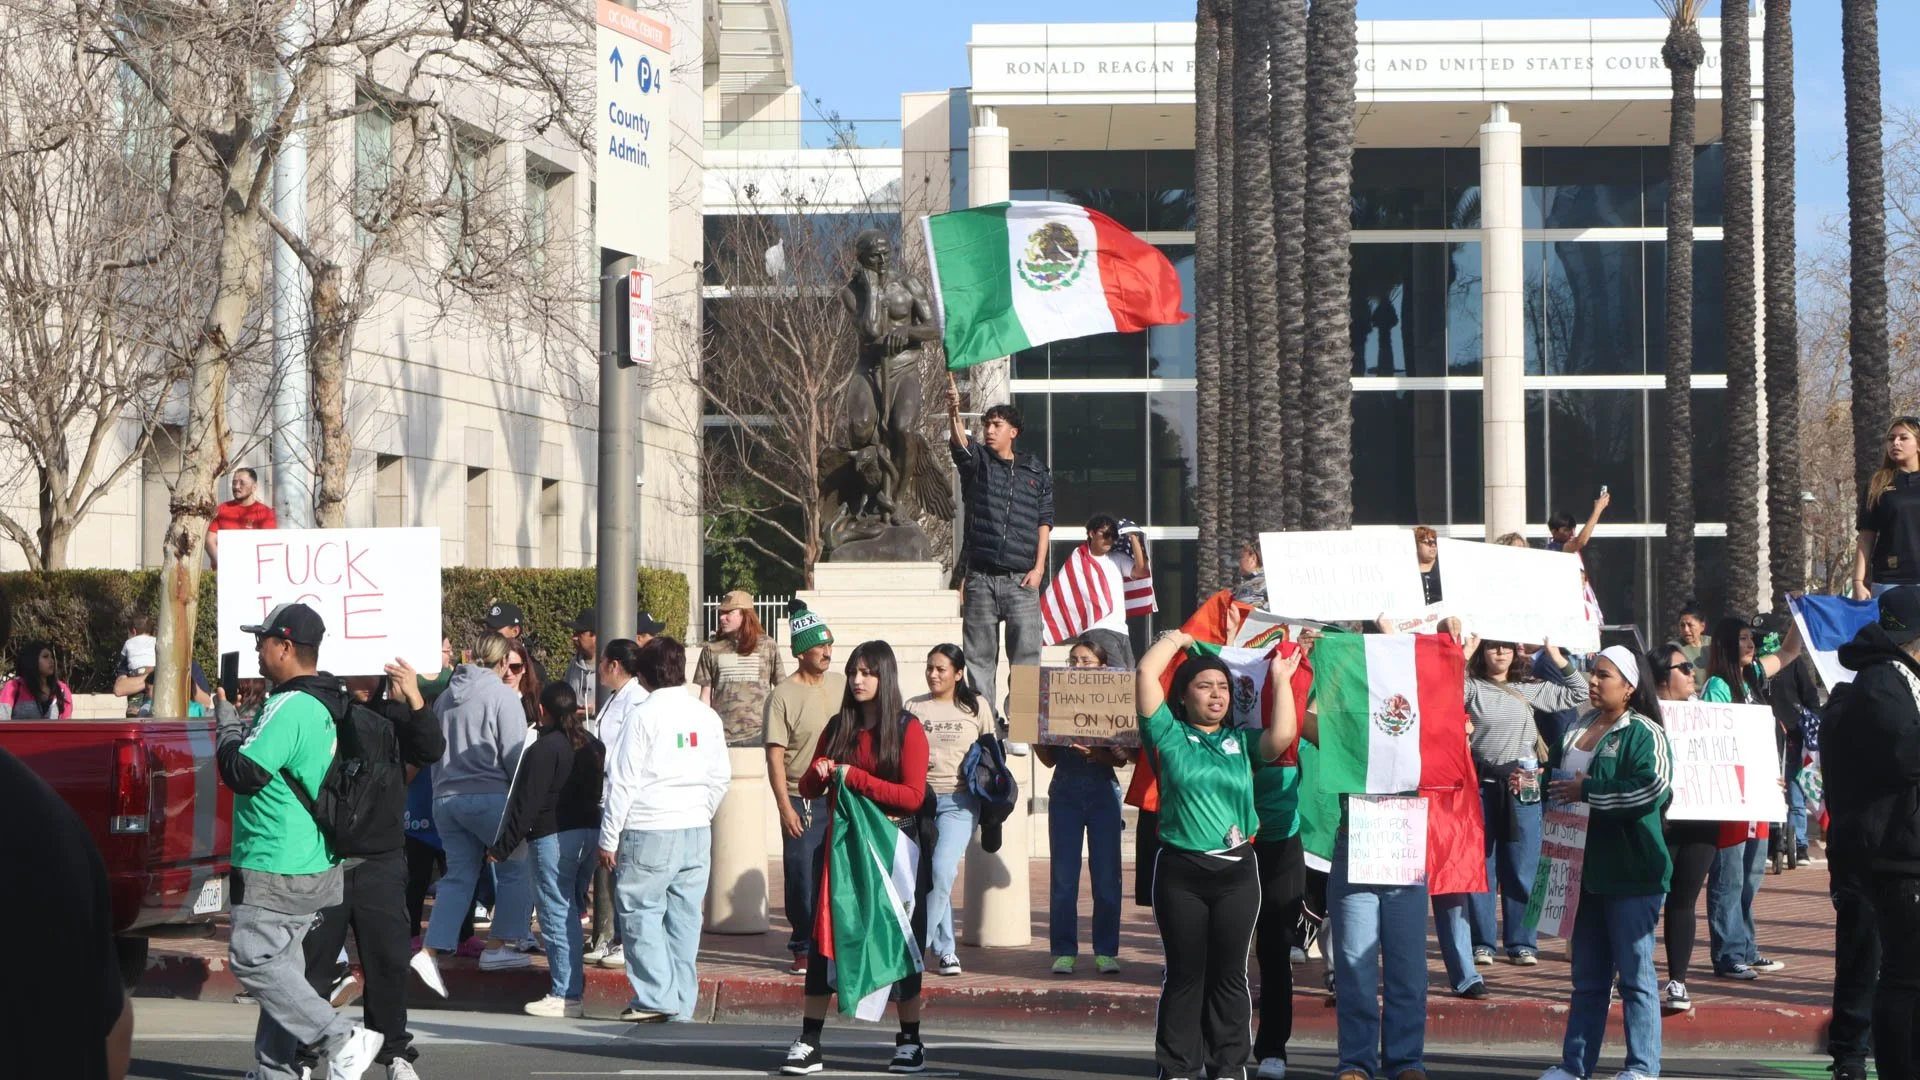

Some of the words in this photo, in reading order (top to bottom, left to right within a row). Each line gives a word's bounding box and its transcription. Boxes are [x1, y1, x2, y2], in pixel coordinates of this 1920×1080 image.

[621, 14, 637, 32] CIVIC
[640, 22, 663, 42] CENTER
[1006, 61, 1085, 74] RONALD
[1098, 60, 1174, 73] REAGAN
[1387, 58, 1428, 71] AND
[1440, 57, 1515, 71] UNITED
[1526, 57, 1594, 70] STATES
[653, 68, 661, 94] 4
[608, 102, 650, 141] County
[608, 135, 650, 168] Admin.
[631, 274, 641, 295] NO
[256, 540, 379, 589] FUCK
[1051, 672, 1064, 684] IT
[1067, 672, 1078, 684] IS
[1079, 673, 1115, 685] BETTER
[1118, 673, 1131, 684] TO
[1052, 692, 1085, 704] THAN
[1089, 693, 1104, 704] TO
[1107, 693, 1132, 704] LIVE
[1073, 712, 1098, 727] ON
[1105, 714, 1139, 729] YOU
[1389, 817, 1412, 830] FOR
[1350, 831, 1361, 845] MY
[1391, 848, 1418, 860] WILL
[1545, 899, 1568, 920] from
